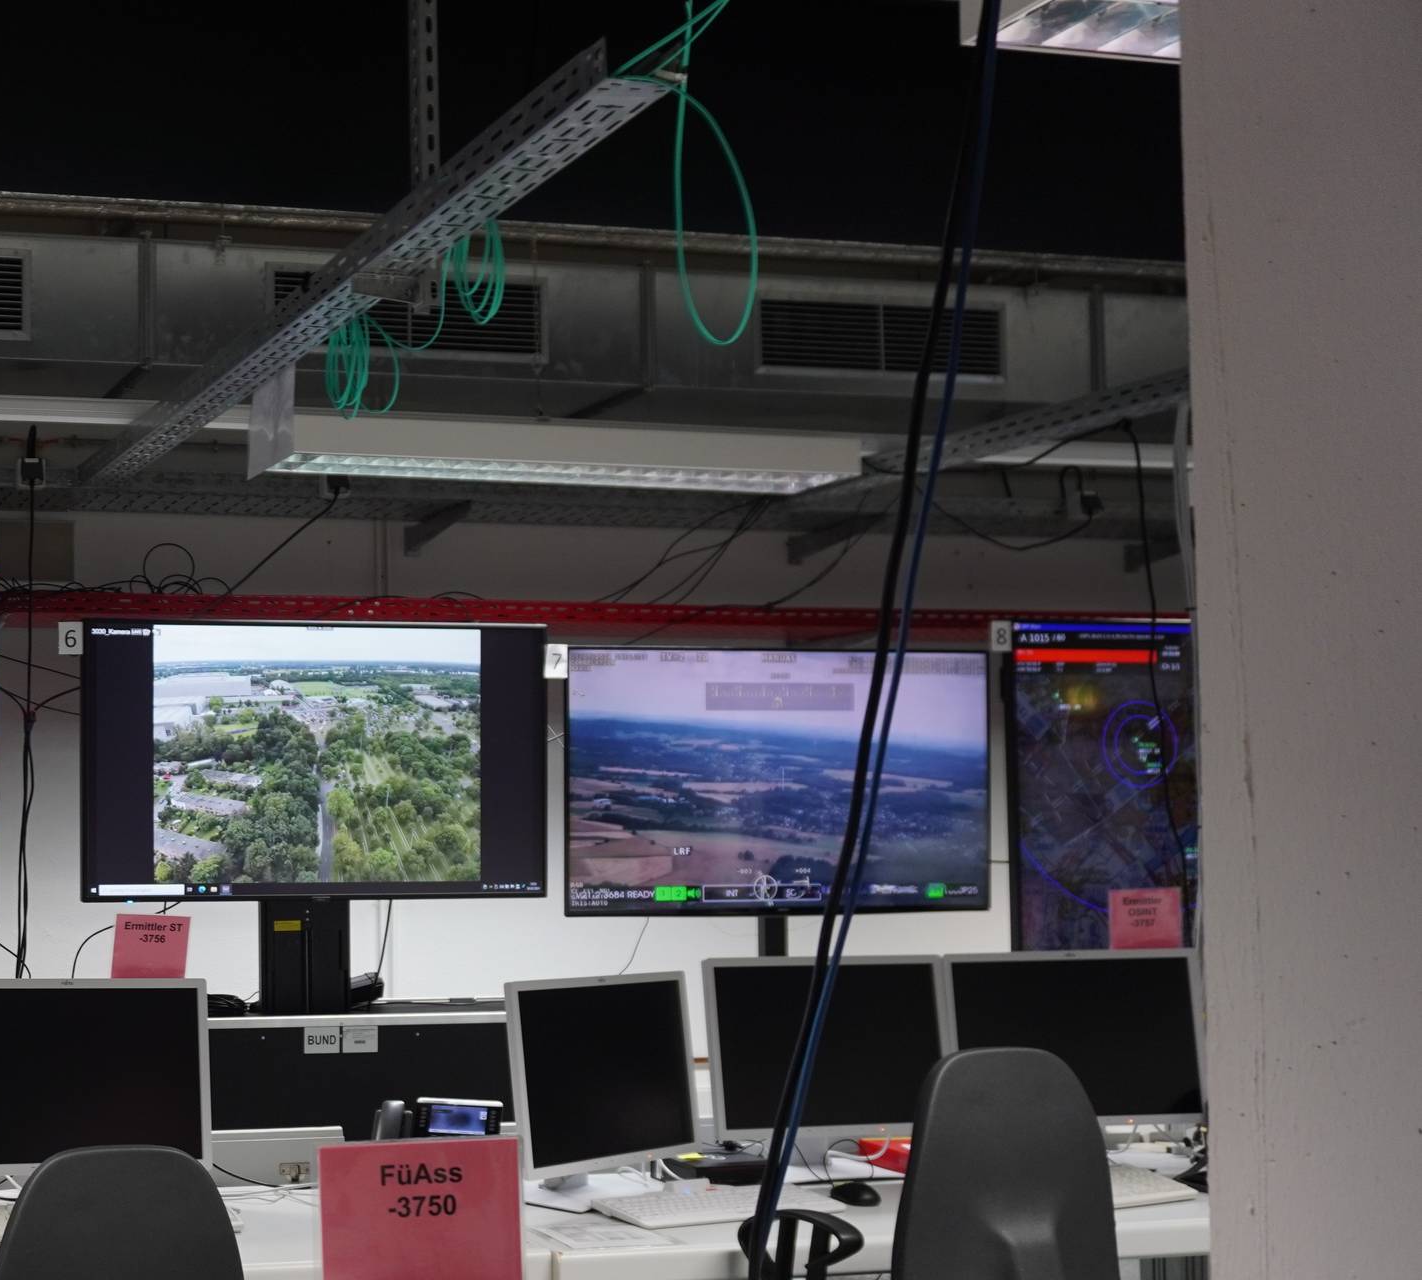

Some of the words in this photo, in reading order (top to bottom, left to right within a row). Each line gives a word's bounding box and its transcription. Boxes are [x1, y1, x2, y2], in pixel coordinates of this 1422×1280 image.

[65, 629, 77, 648] 6
[996, 627, 1007, 645] 8
[552, 652, 563, 670] 7
[673, 847, 691, 855] LRF
[627, 891, 655, 899] READY
[124, 922, 167, 932] Ermittler
[169, 923, 184, 932] ST
[139, 934, 166, 943] -3756
[307, 1034, 337, 1045] BUND
[380, 1163, 462, 1186] FüAss
[388, 1194, 456, 1217] -3750
